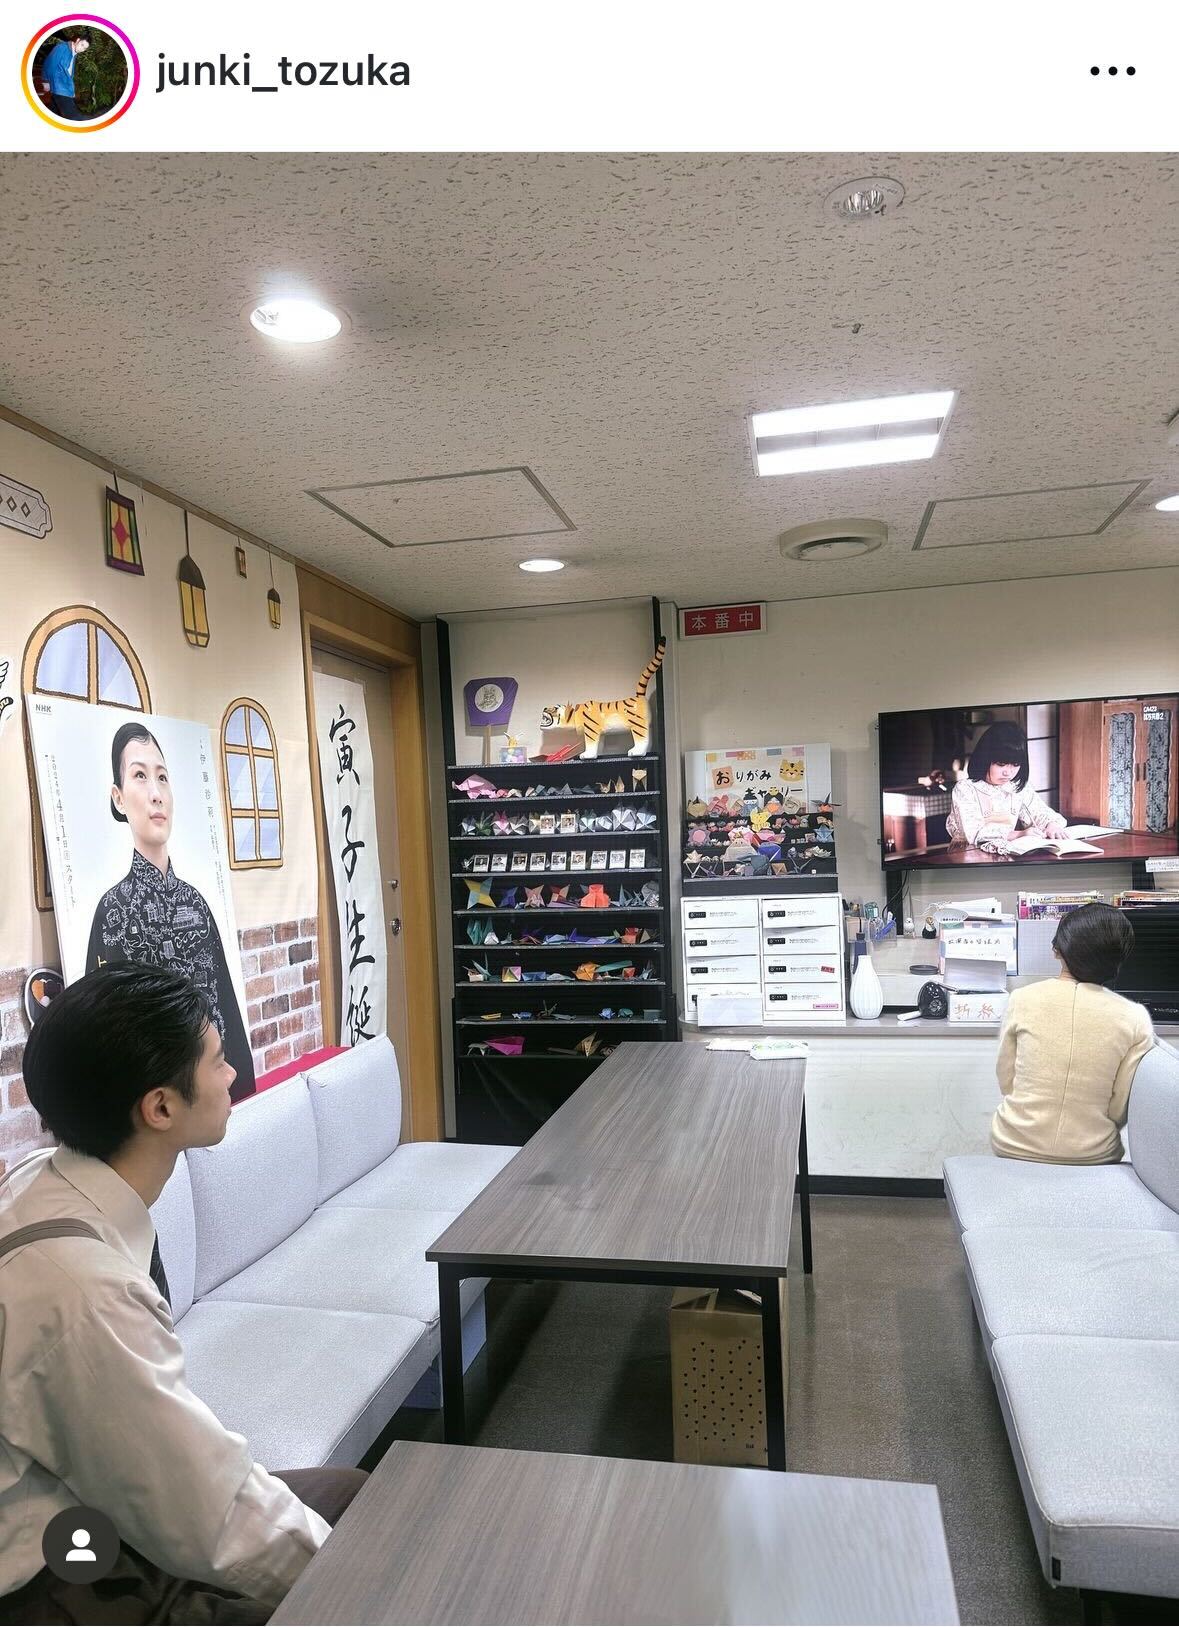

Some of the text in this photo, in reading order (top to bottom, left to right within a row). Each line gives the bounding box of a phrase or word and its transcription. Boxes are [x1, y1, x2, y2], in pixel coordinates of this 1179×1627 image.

[691, 611, 754, 631] 本番中
[35, 703, 52, 713] NHK
[716, 769, 772, 786] おりがみ
[744, 786, 803, 799] ギャリー
